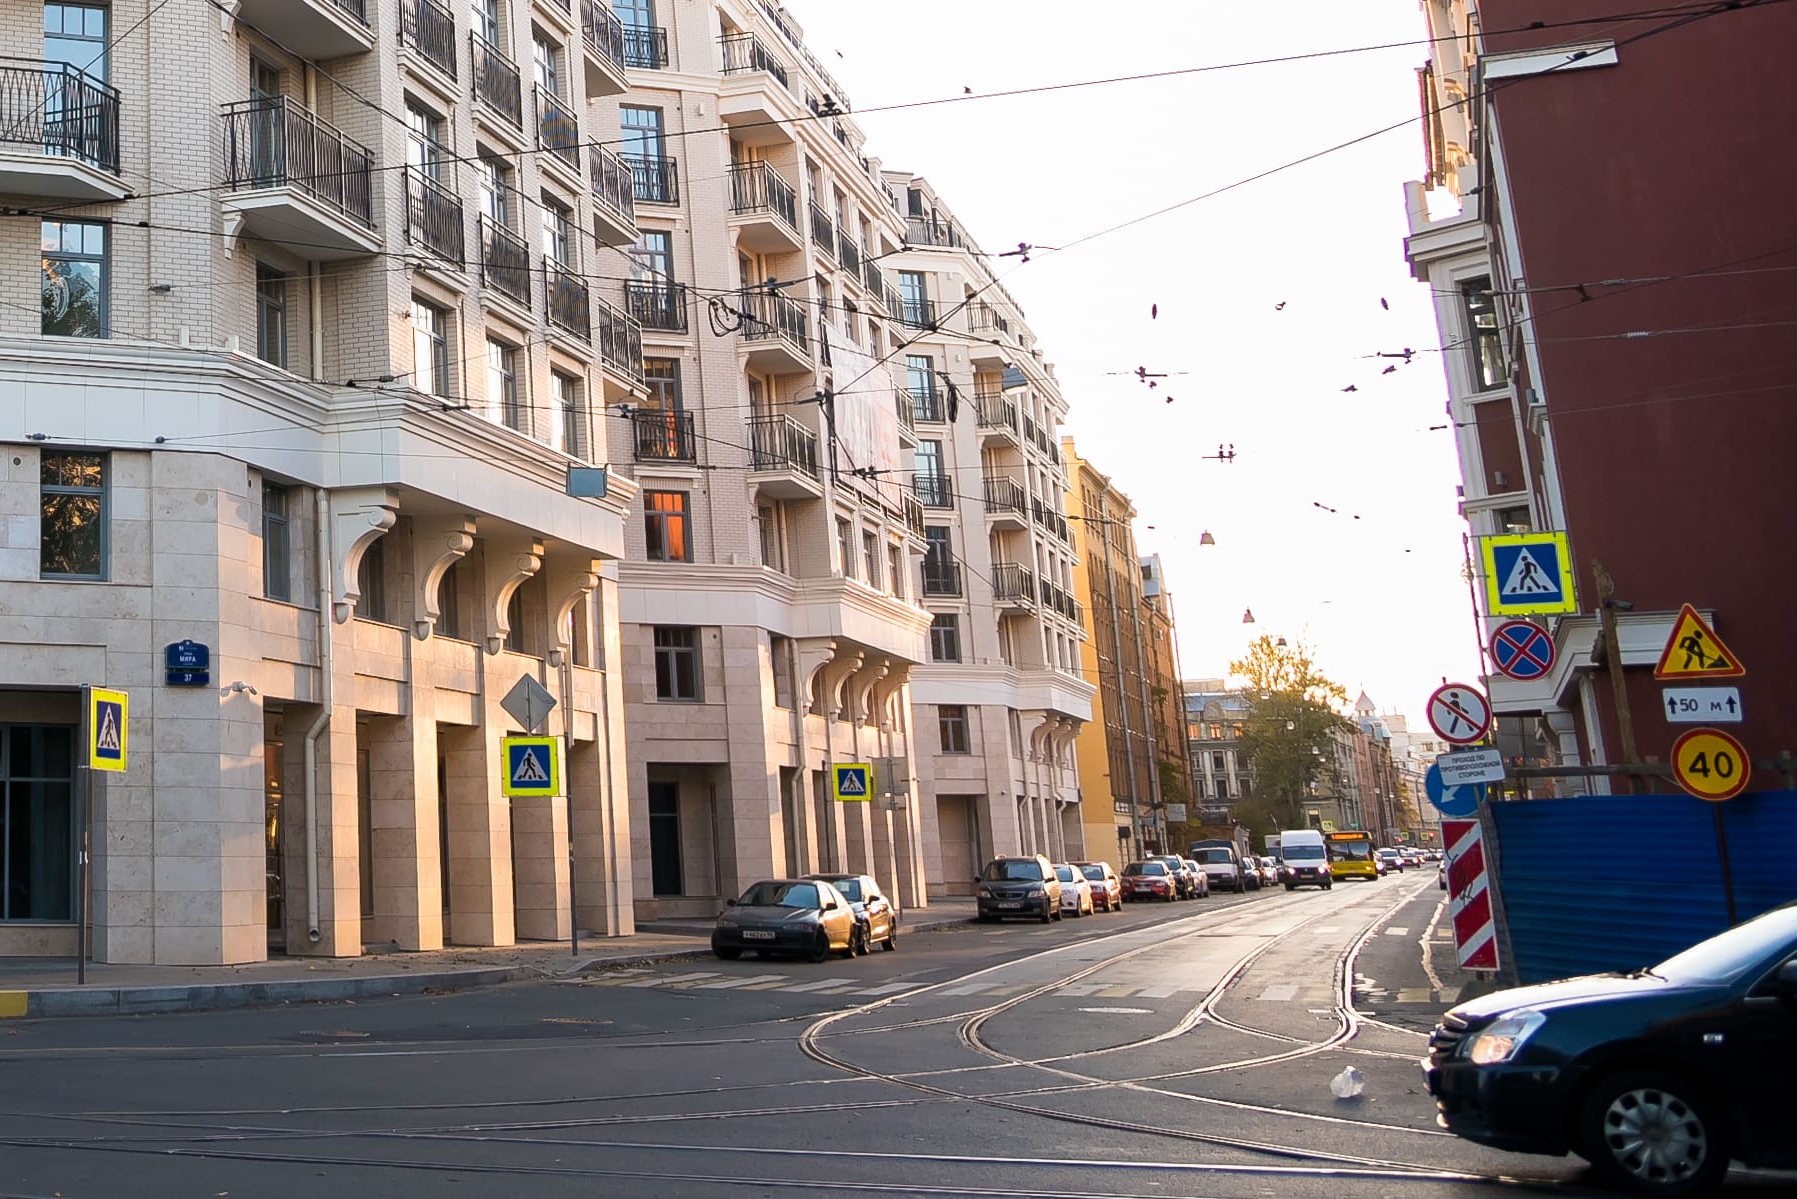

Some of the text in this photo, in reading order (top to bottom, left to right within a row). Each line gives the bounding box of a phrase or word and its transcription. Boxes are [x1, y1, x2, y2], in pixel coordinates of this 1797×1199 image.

[184, 673, 192, 681] 37
[1679, 698, 1699, 712] 50
[1688, 751, 1734, 779] 40
